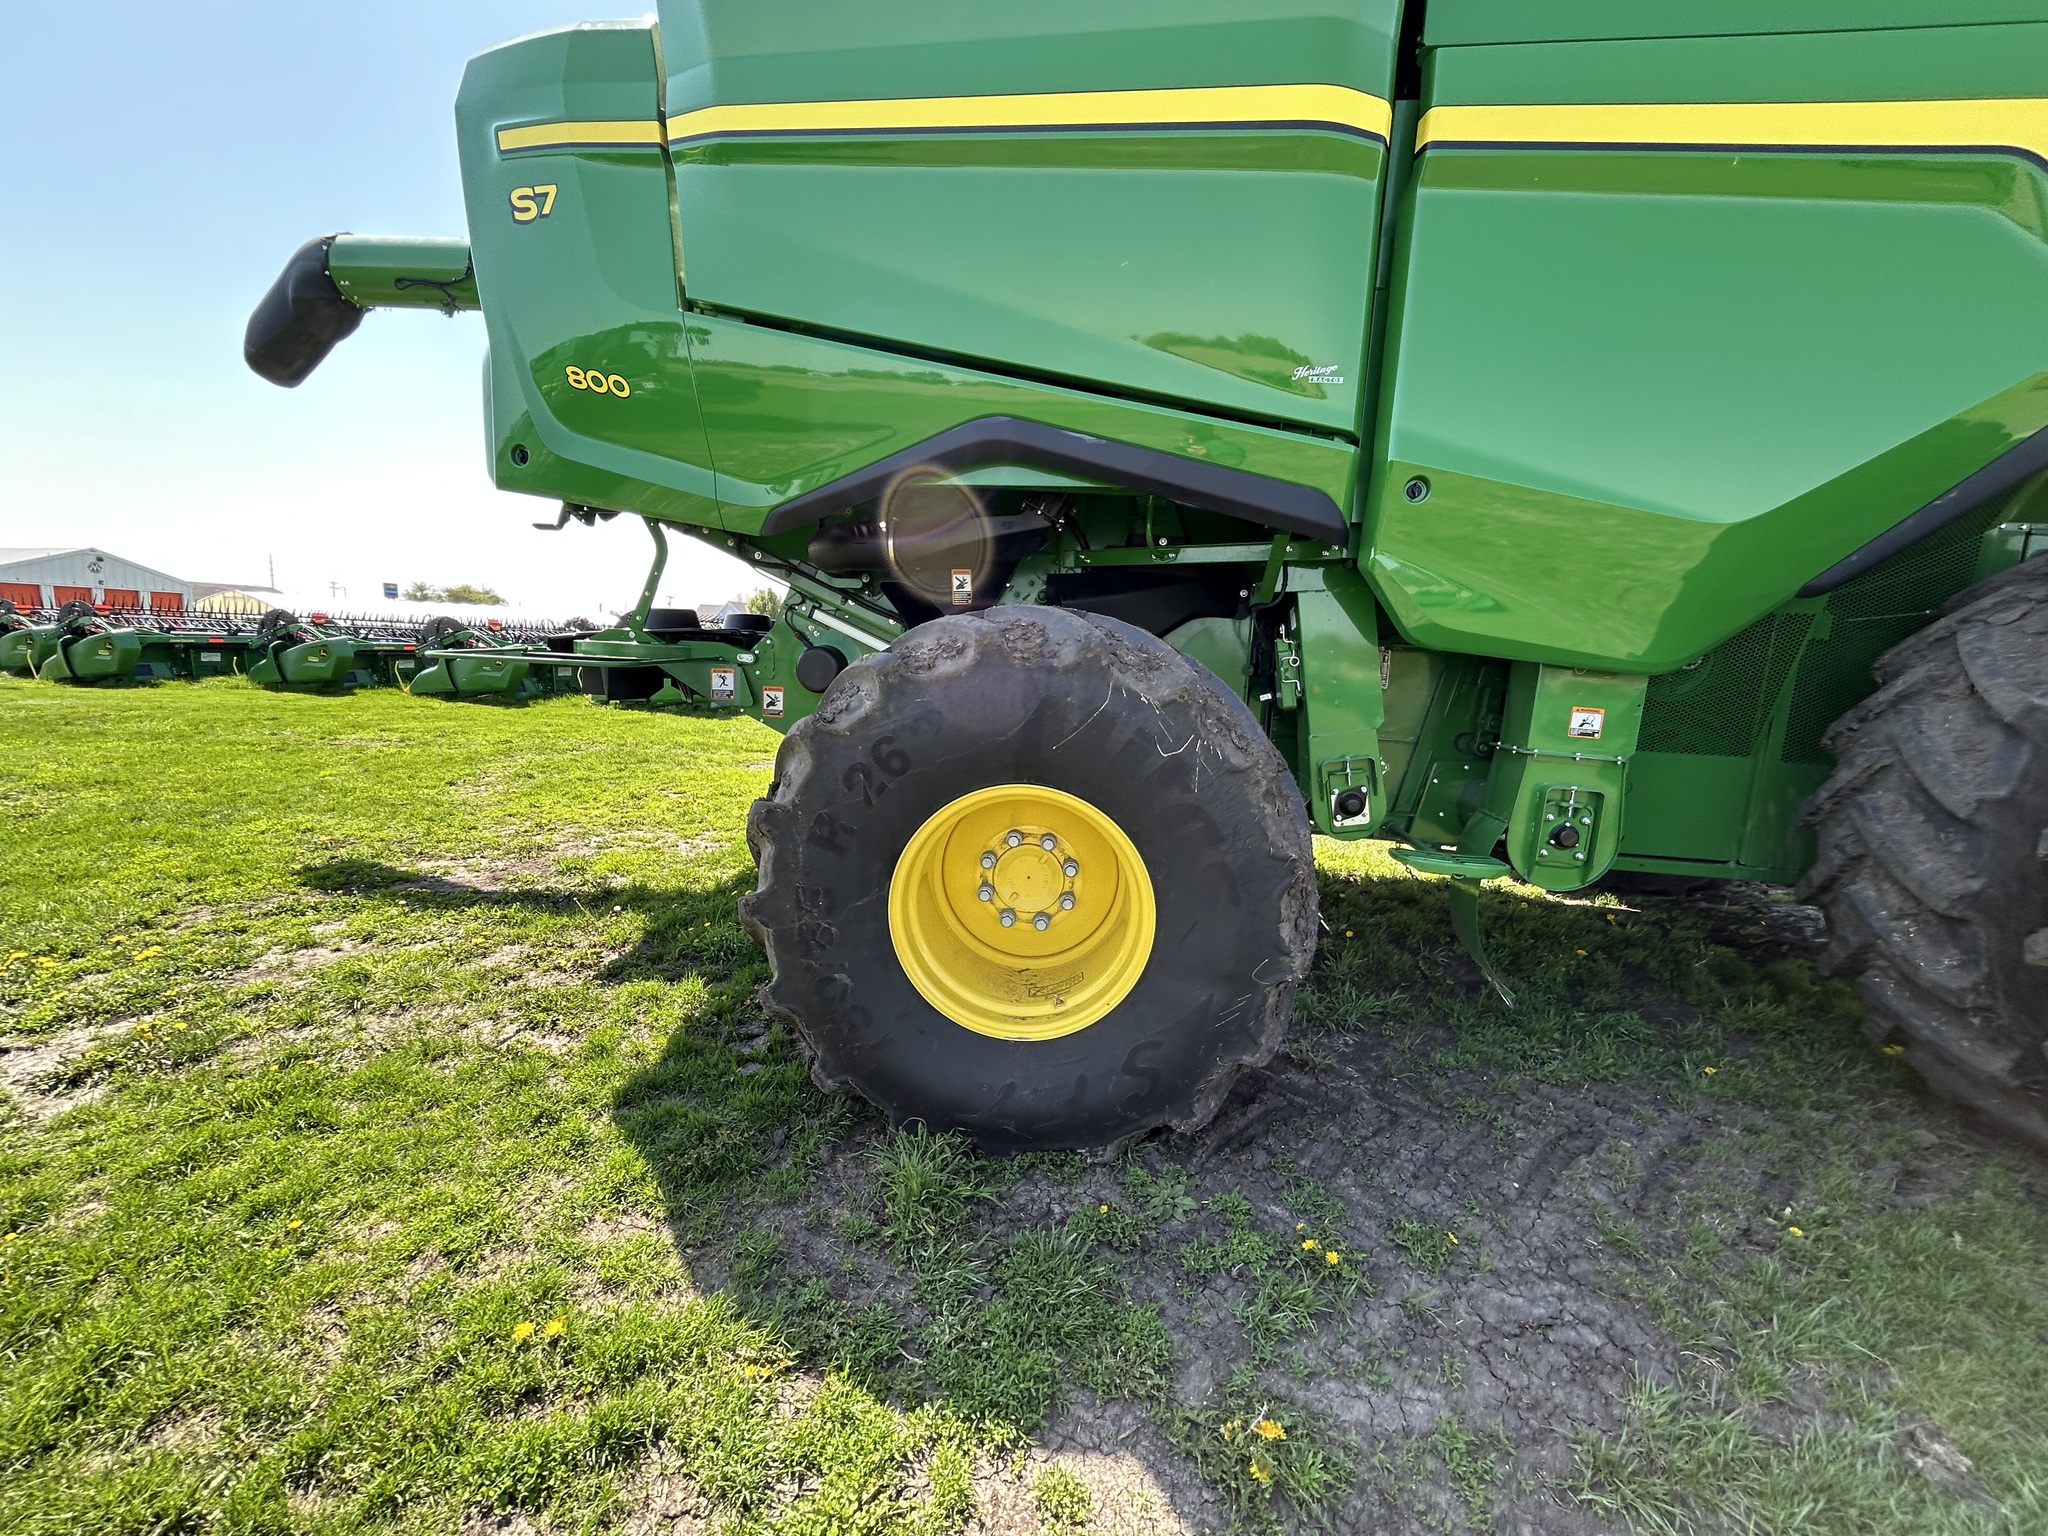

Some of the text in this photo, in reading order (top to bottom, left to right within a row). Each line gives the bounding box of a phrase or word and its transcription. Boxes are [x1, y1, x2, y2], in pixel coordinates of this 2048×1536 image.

[509, 184, 557, 225] S7
[565, 365, 631, 398] 800
[1292, 364, 1338, 380] Heritage
[843, 735, 913, 808] 26
